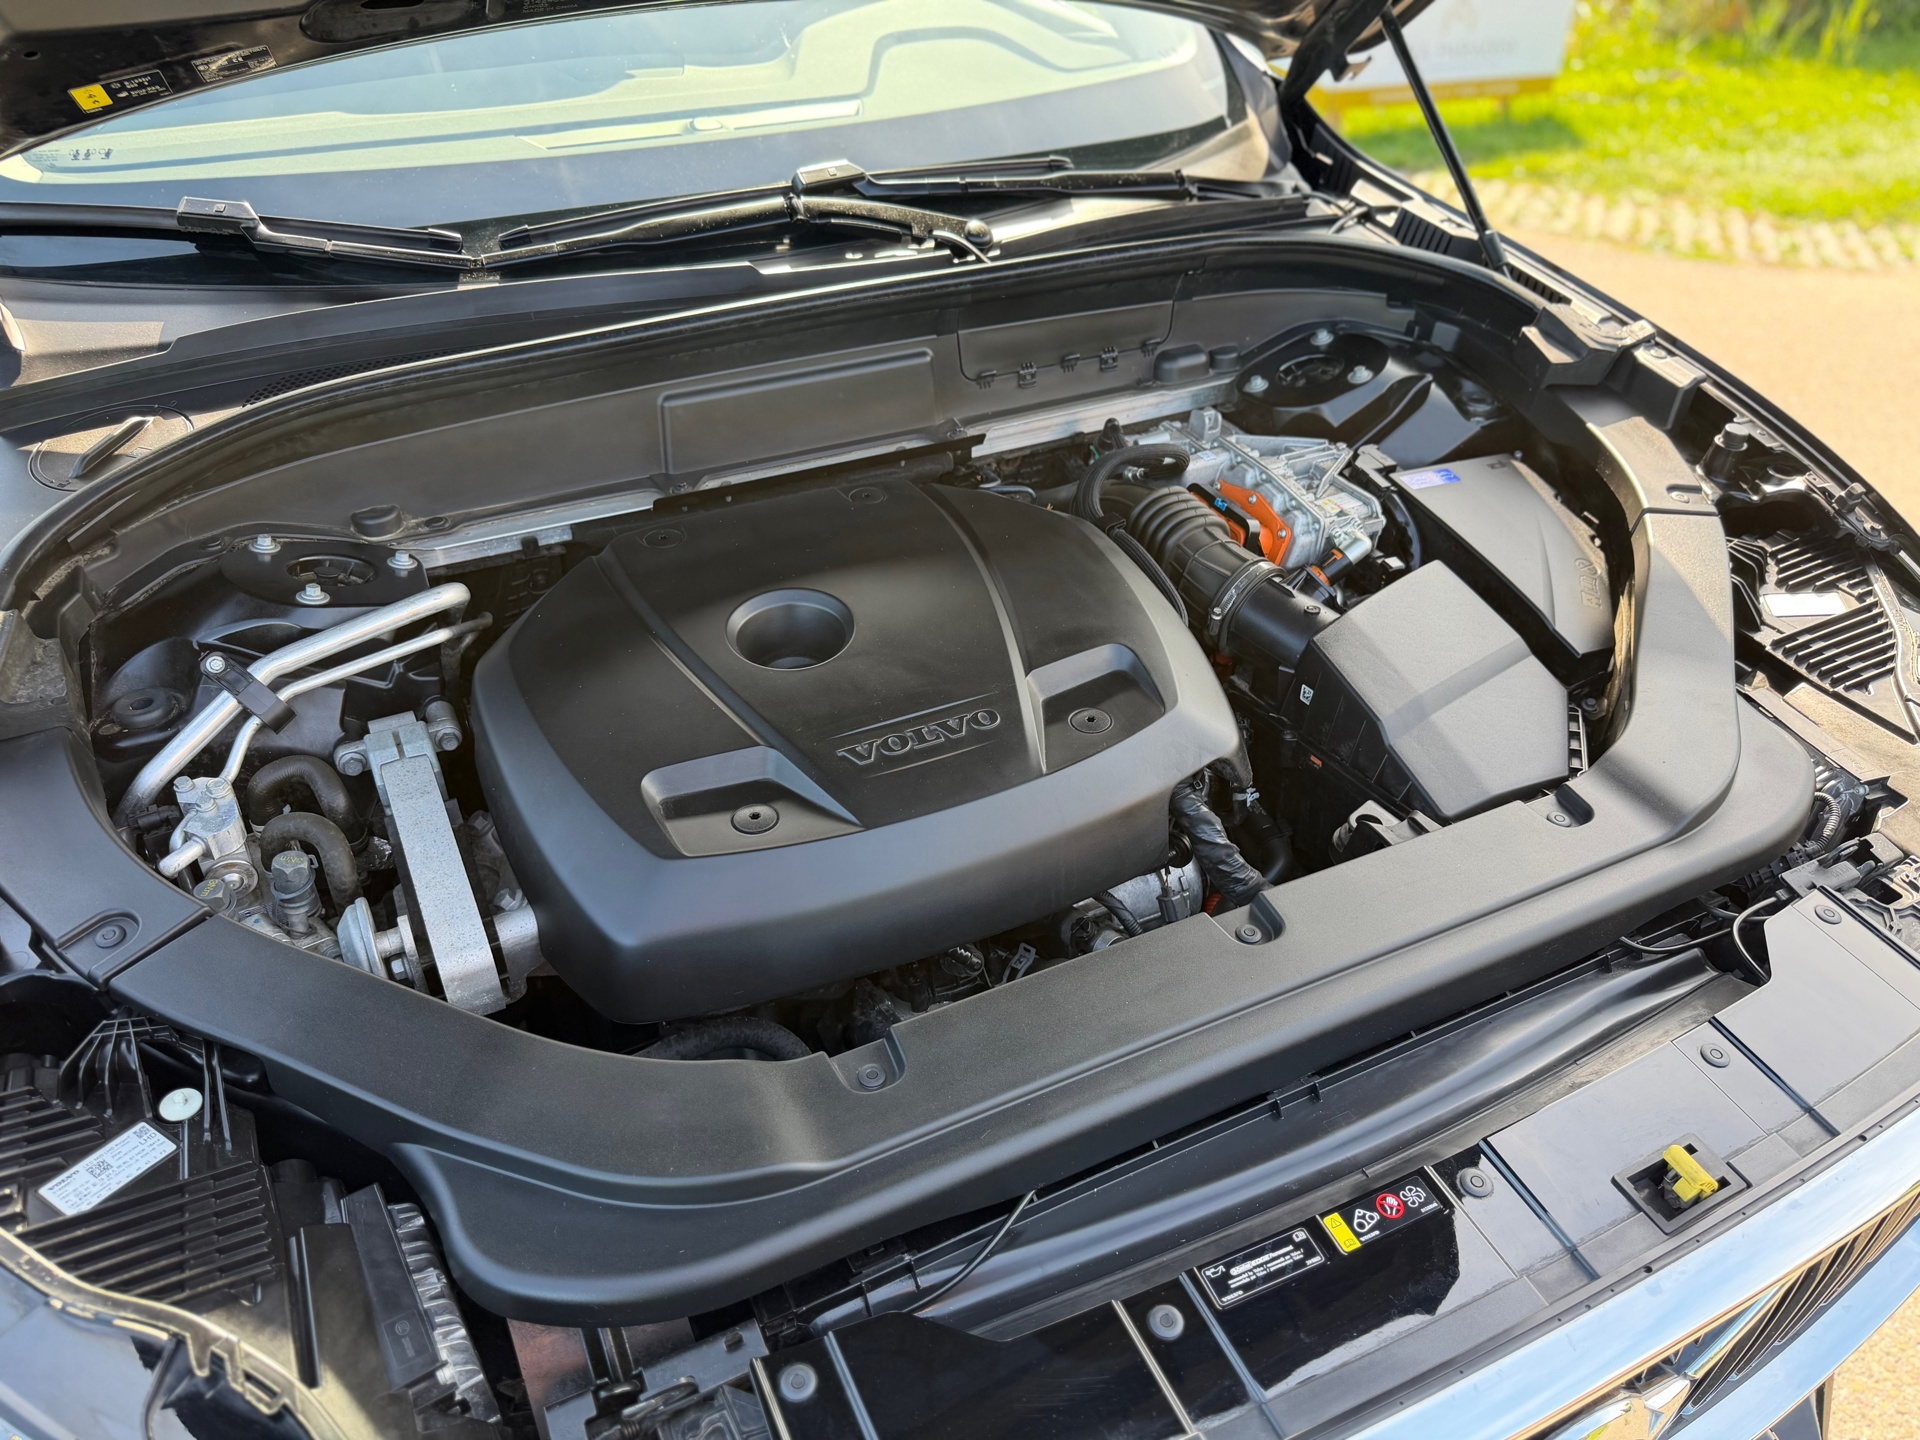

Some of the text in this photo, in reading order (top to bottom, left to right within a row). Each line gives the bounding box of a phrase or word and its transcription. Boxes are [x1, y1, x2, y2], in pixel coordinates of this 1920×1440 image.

[836, 708, 1001, 766] VOLVO
[139, 1132, 158, 1146] LHD
[47, 1170, 80, 1191] VOLVO
